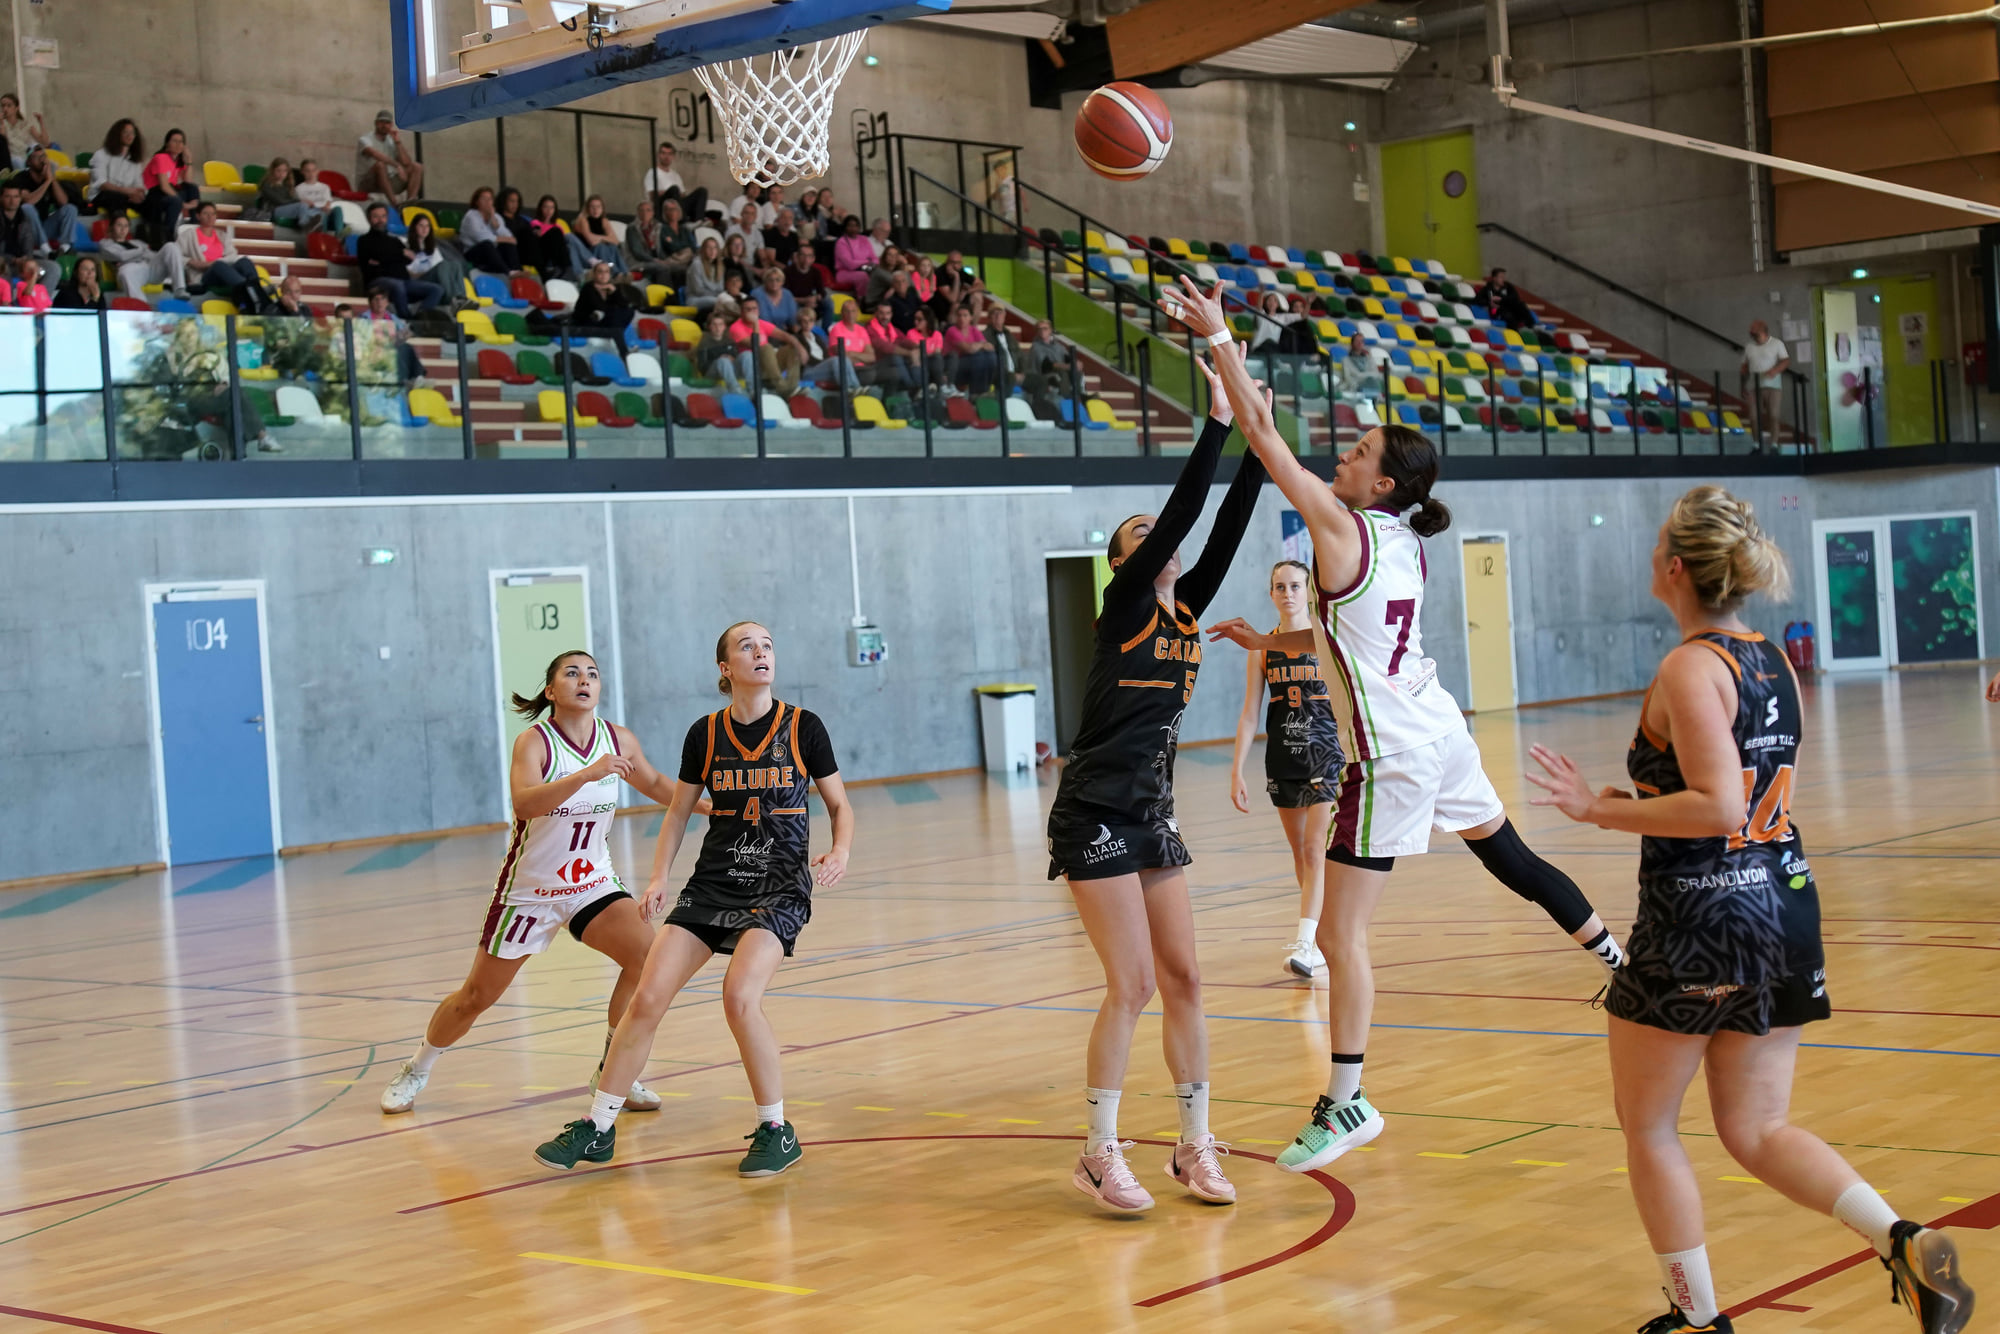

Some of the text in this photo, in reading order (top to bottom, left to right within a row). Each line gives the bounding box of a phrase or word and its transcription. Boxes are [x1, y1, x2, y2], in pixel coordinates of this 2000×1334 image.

[1385, 598, 1416, 677] 7
[1183, 669, 1197, 704] 5
[1287, 685, 1302, 708] 9
[712, 766, 795, 791] CALUIRE
[545, 806, 570, 818] PB
[743, 797, 761, 826] 4
[568, 821, 597, 852] 11
[1083, 838, 1127, 859] ILIADE
[504, 915, 538, 944] 11
